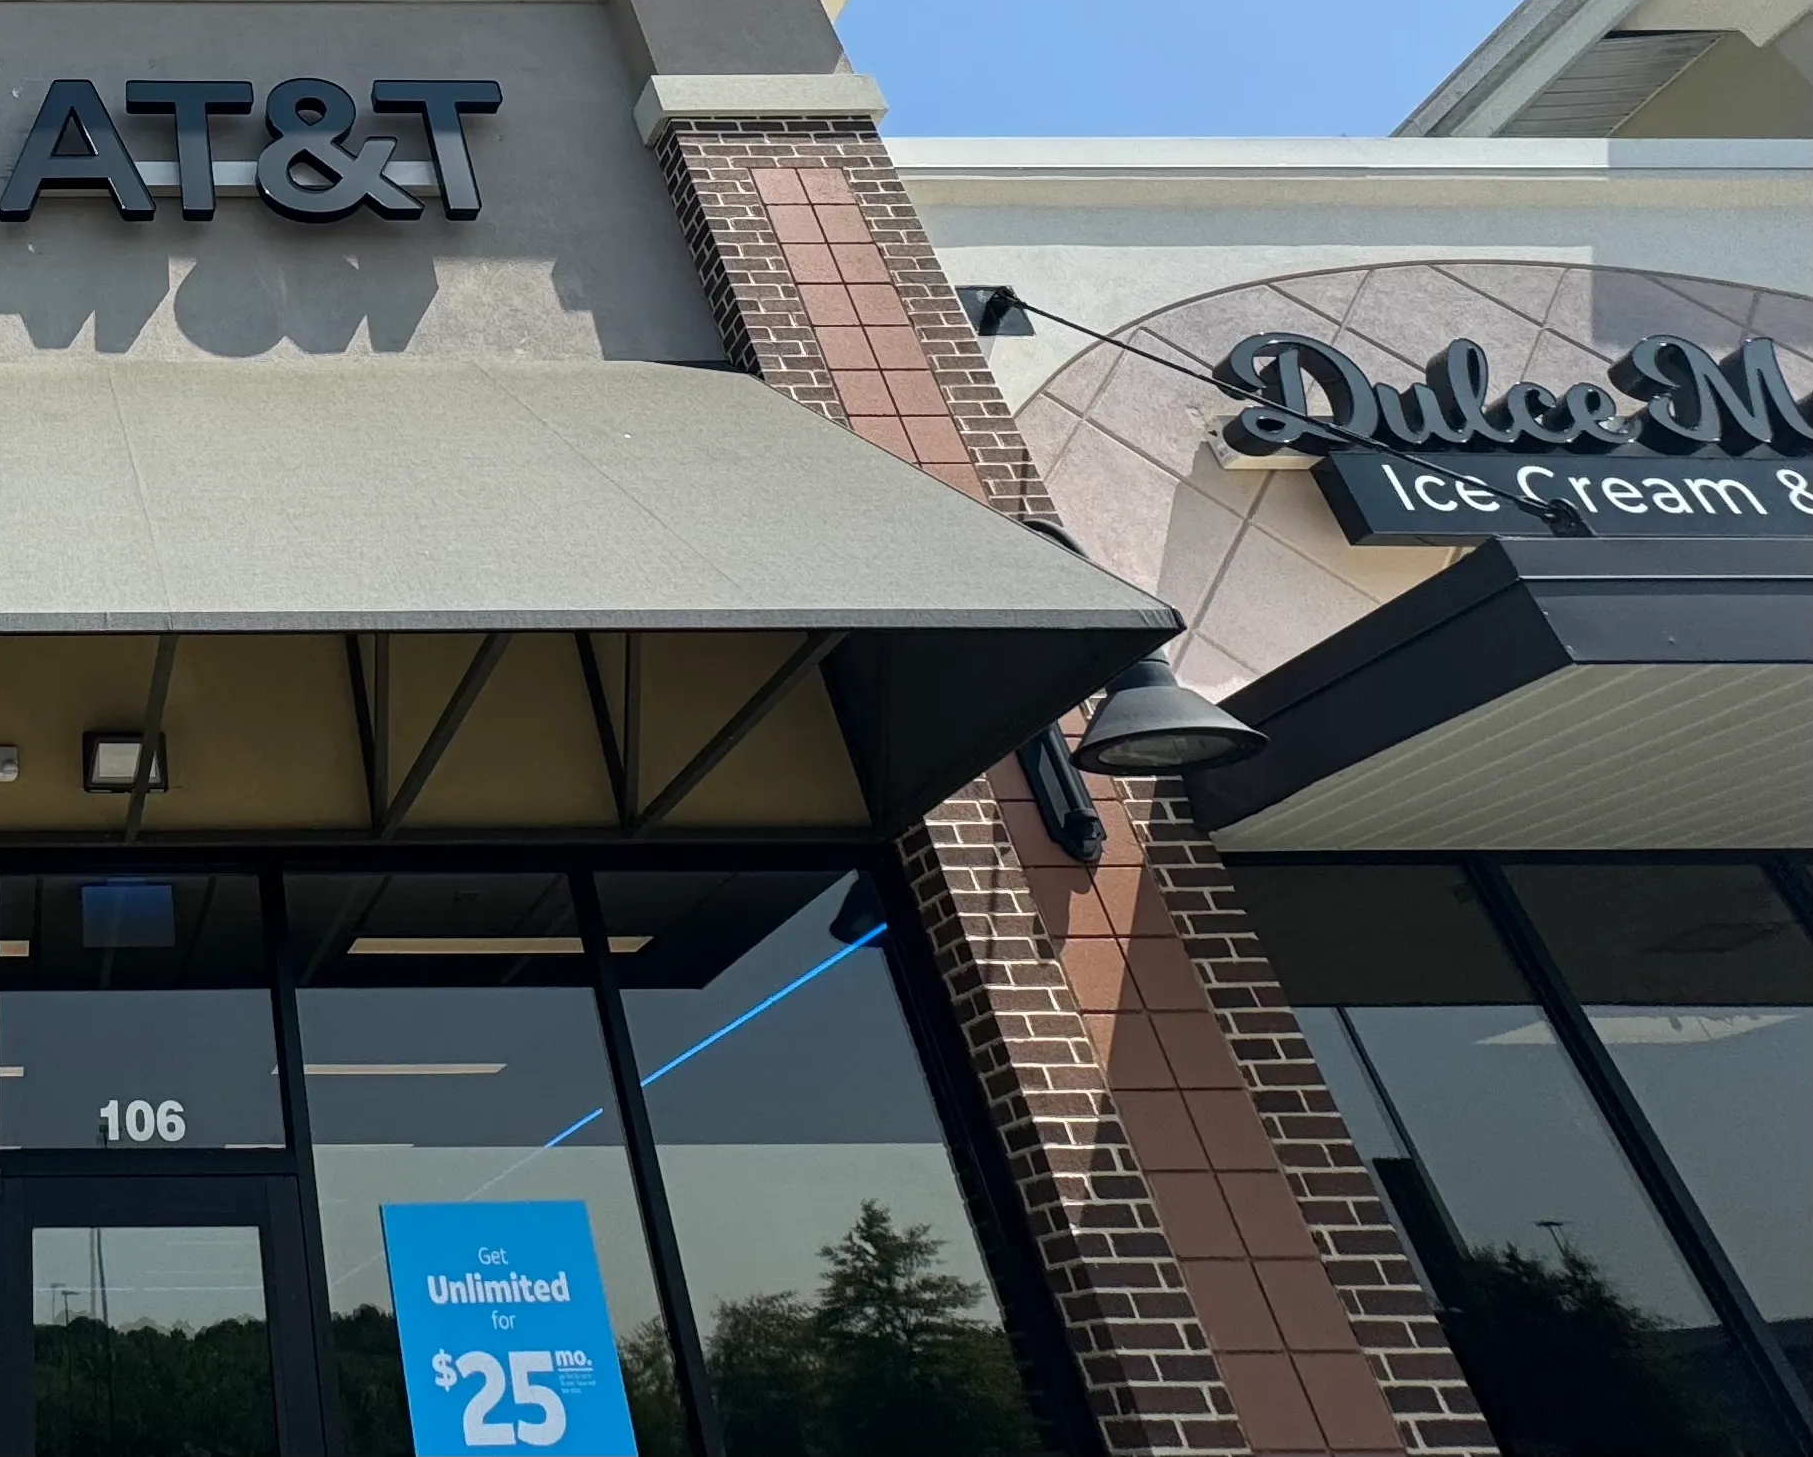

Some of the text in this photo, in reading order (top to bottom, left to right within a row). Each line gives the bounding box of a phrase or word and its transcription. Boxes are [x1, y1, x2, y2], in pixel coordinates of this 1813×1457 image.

[0, 78, 502, 223] AT&T
[1216, 332, 1641, 452] Dulce
[1380, 463, 1500, 512] Ice
[1516, 465, 1769, 515] Cream
[99, 1099, 186, 1143] 106
[477, 1246, 509, 1266] Get
[426, 1271, 571, 1305] Unlimited
[491, 1310, 517, 1330] for
[431, 1348, 593, 1447] $25 mo.
